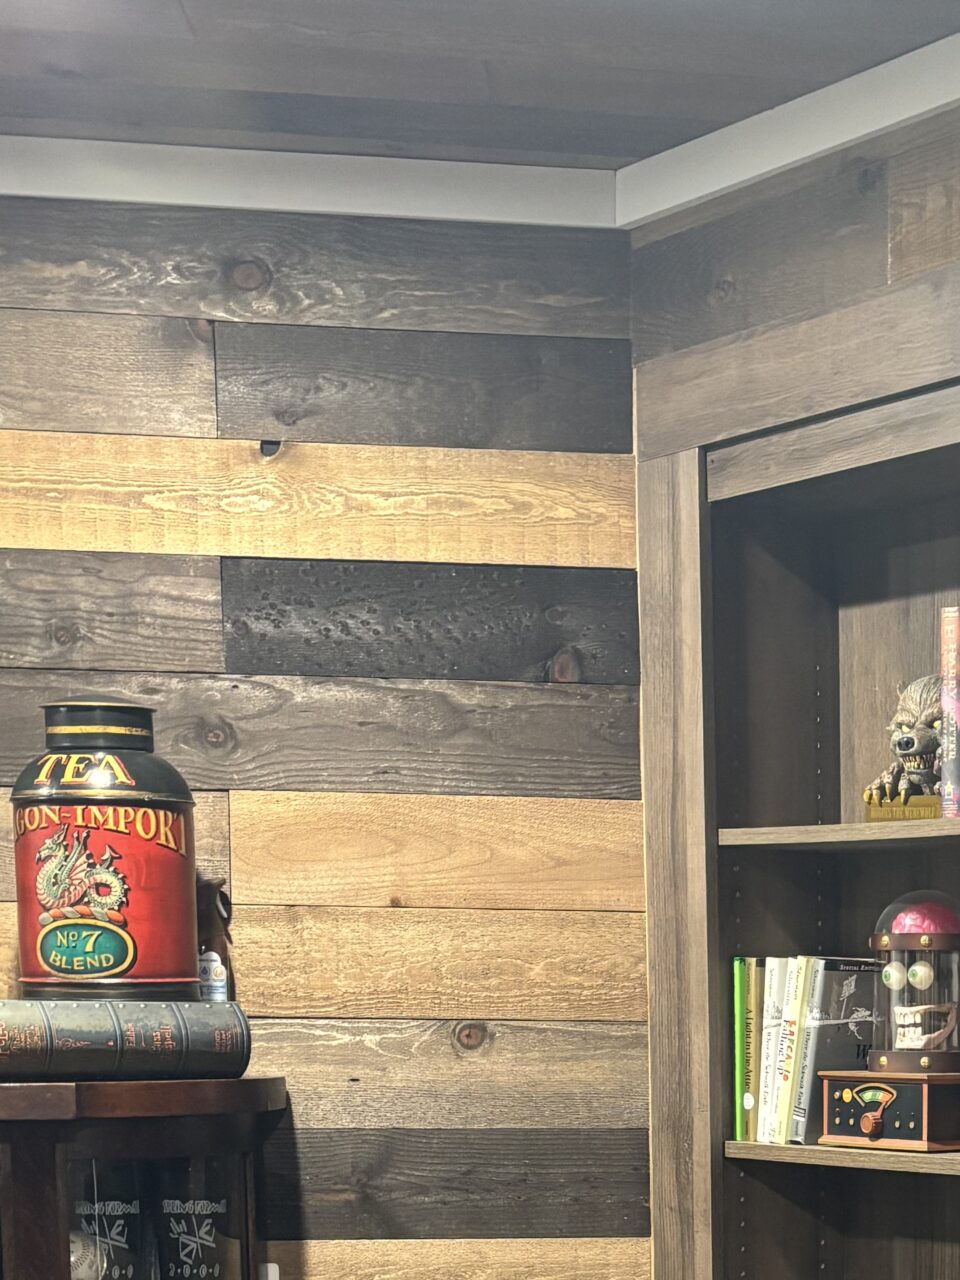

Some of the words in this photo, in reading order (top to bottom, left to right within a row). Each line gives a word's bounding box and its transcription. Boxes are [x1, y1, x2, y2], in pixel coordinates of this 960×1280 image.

[948, 643, 957, 700] HARRY
[948, 705, 957, 760] POTTER
[34, 754, 136, 786] TEA
[81, 930, 102, 952] 7
[49, 950, 115, 970] BLEND
[744, 1017, 754, 1039] Light
[778, 1019, 790, 1057] Falling
[744, 1067, 753, 1092] Attic
